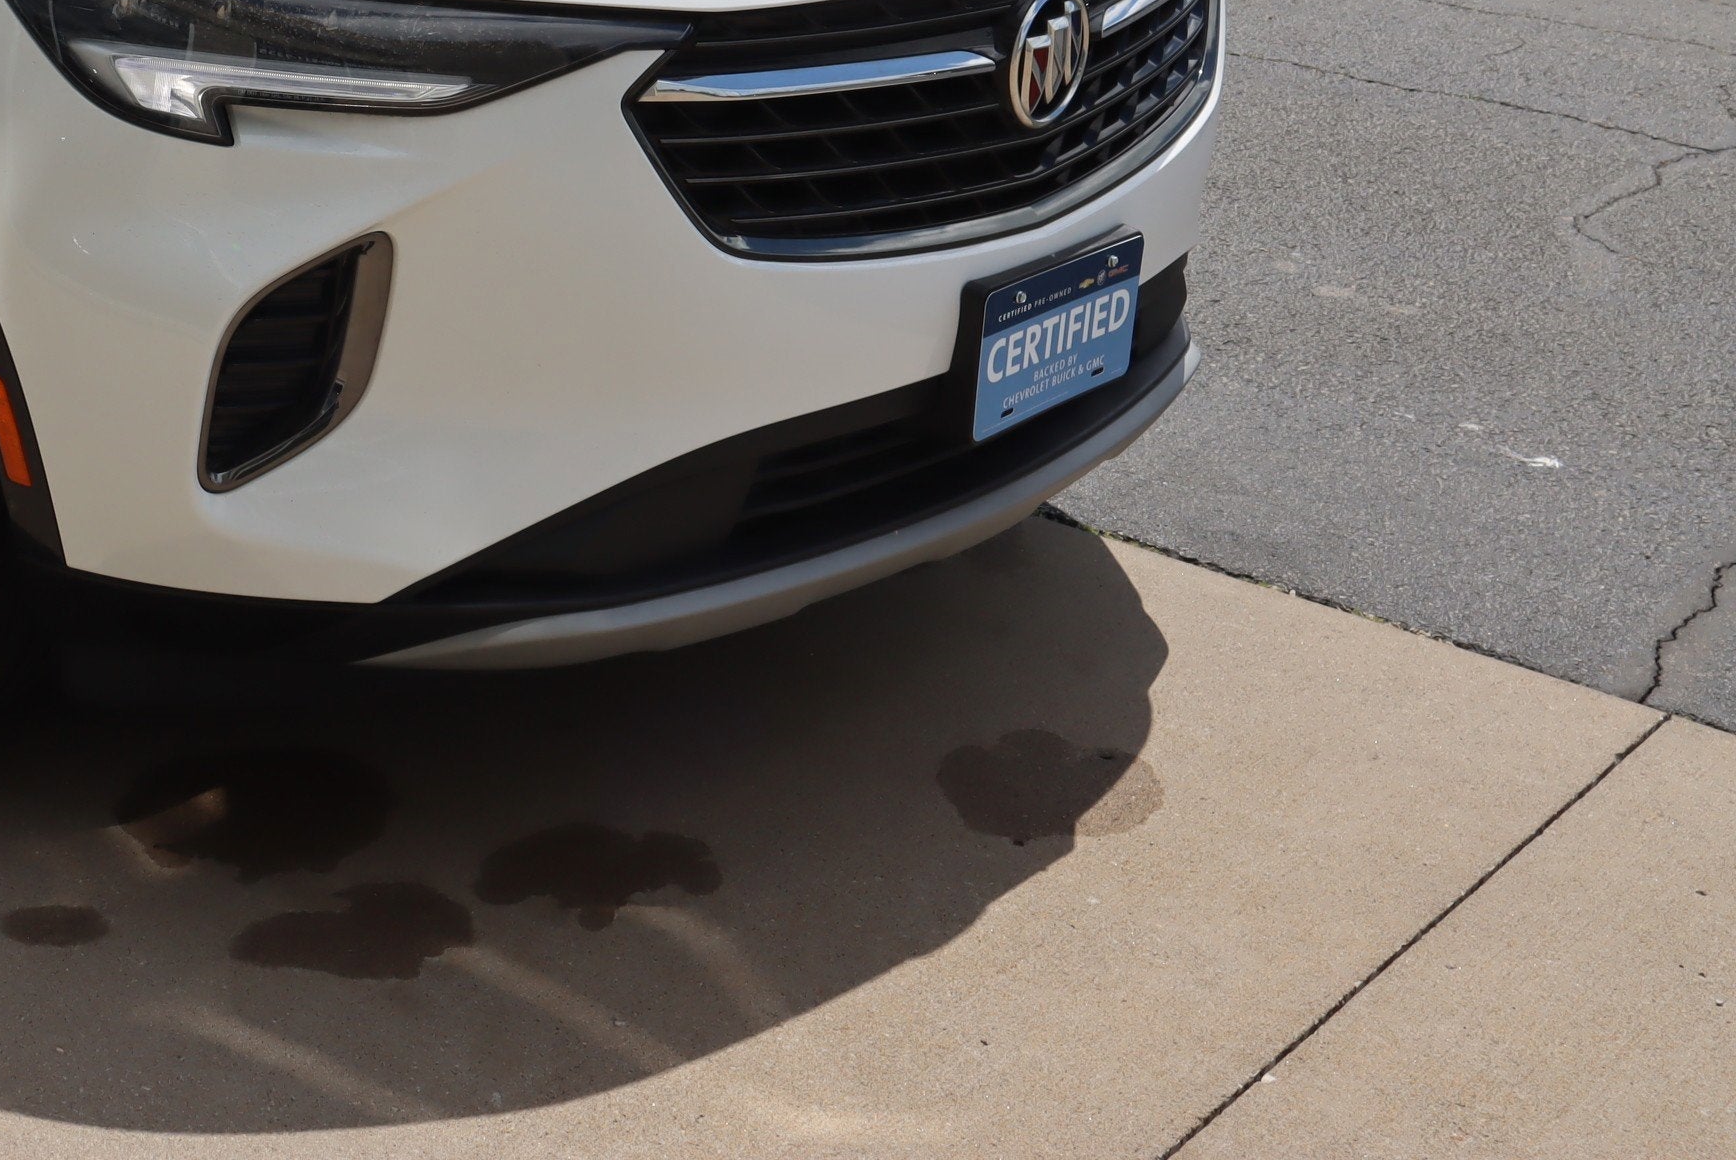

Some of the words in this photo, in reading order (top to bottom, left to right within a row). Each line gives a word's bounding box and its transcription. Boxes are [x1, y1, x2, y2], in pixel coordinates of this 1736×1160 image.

[998, 303, 1032, 323] CERTIFIED
[1033, 287, 1072, 308] PRE-OWNED
[986, 288, 1131, 384] CERTIFIED
[1002, 379, 1050, 409] CHEVROLET
[1051, 366, 1076, 387] BUICK
[1077, 365, 1084, 375] &
[1086, 354, 1105, 371] GMC
[1033, 358, 1066, 382] BACKED
[1067, 354, 1078, 367] BY
